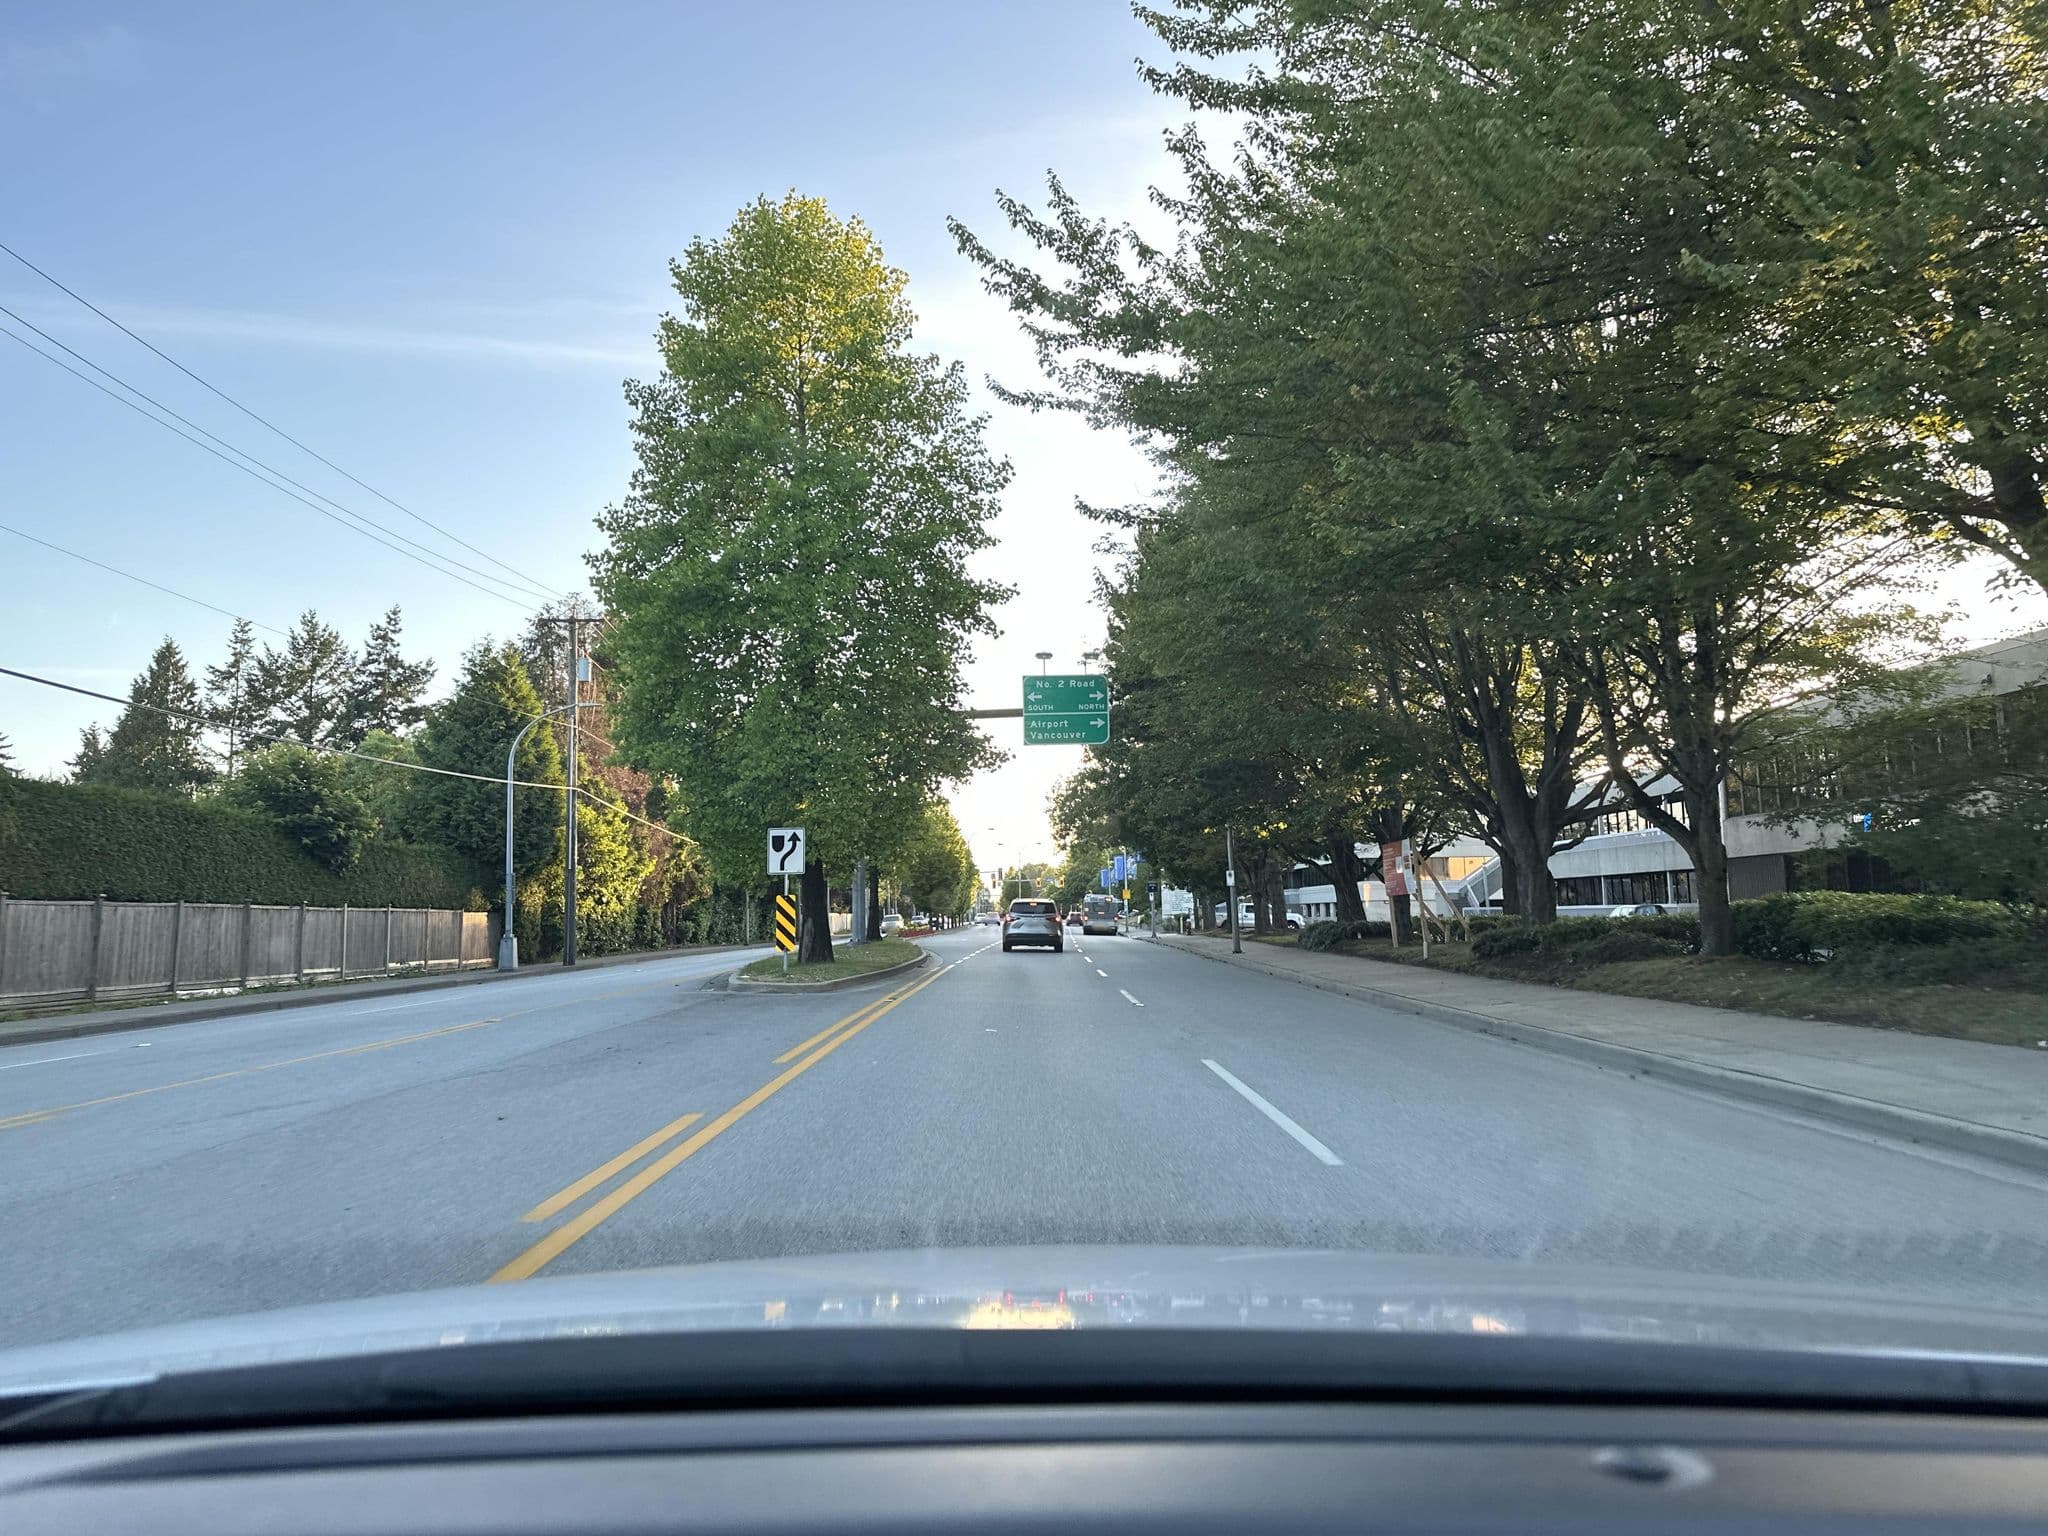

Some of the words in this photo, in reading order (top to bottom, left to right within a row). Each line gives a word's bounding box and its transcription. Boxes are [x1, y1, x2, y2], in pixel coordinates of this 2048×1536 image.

[1036, 680, 1052, 688] No.
[1058, 680, 1065, 688] 2
[1030, 720, 1069, 729] Airport
[1030, 731, 1086, 739] Vancouver
